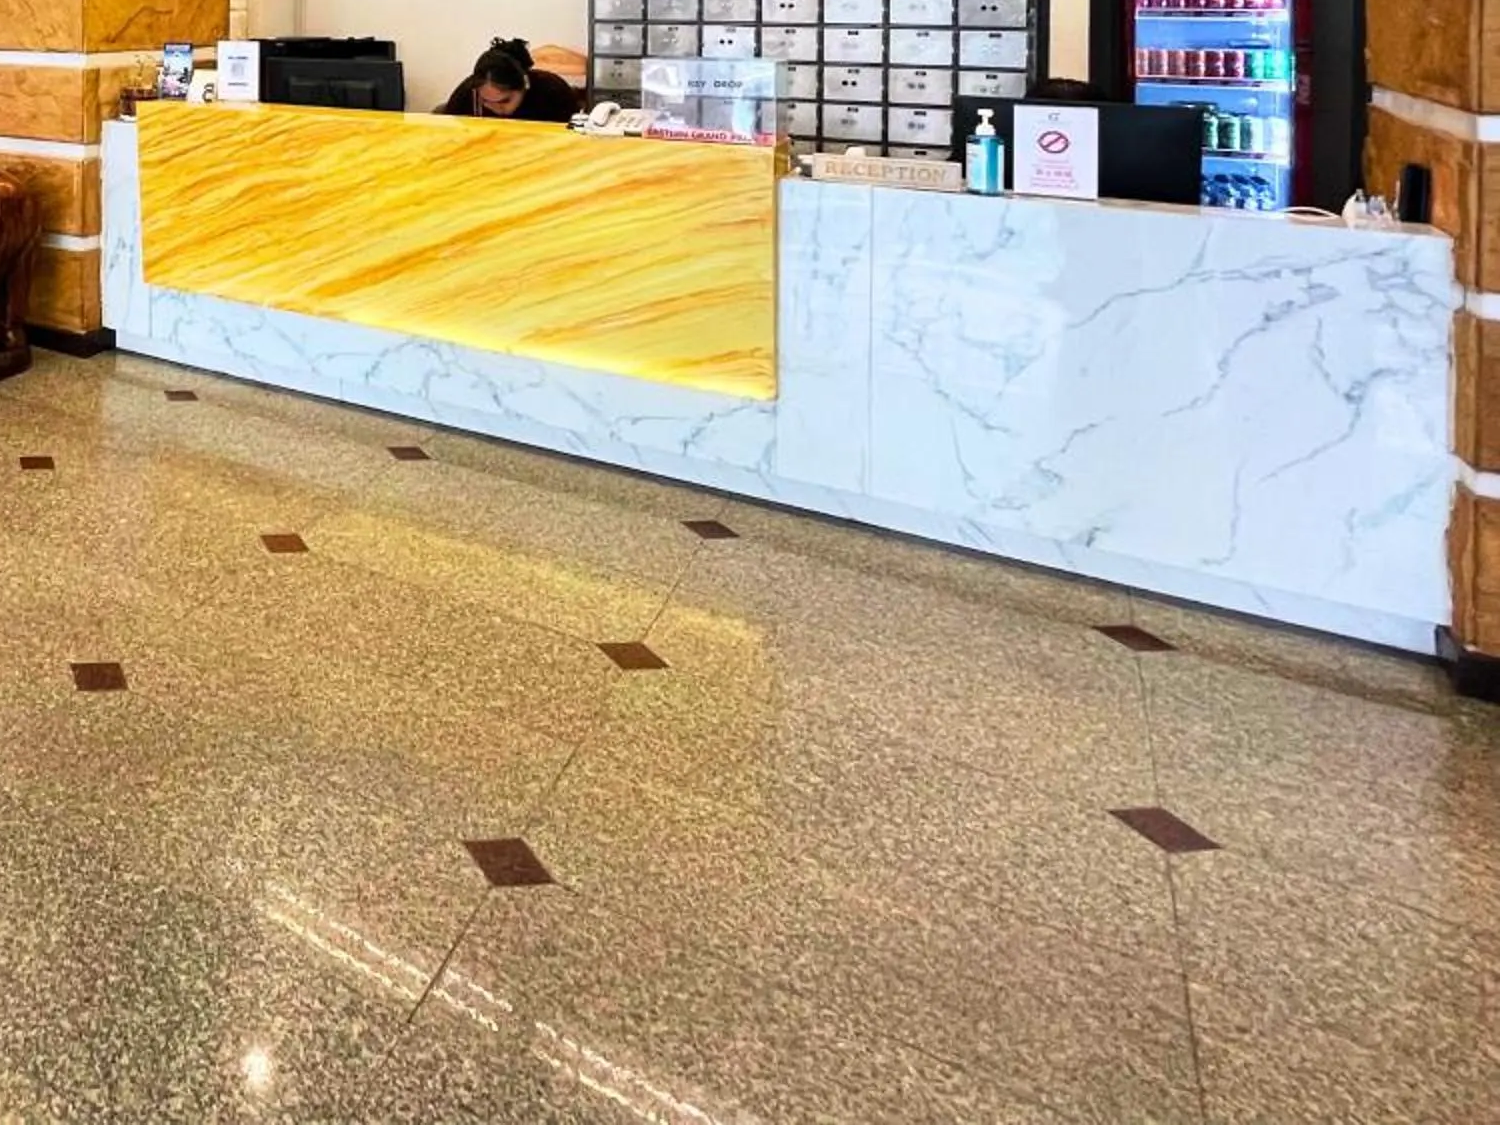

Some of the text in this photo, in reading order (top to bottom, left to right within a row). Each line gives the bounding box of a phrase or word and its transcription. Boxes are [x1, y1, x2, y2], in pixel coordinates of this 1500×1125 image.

[687, 79, 744, 89] KEY DROP
[824, 160, 947, 184] RECEPTION
